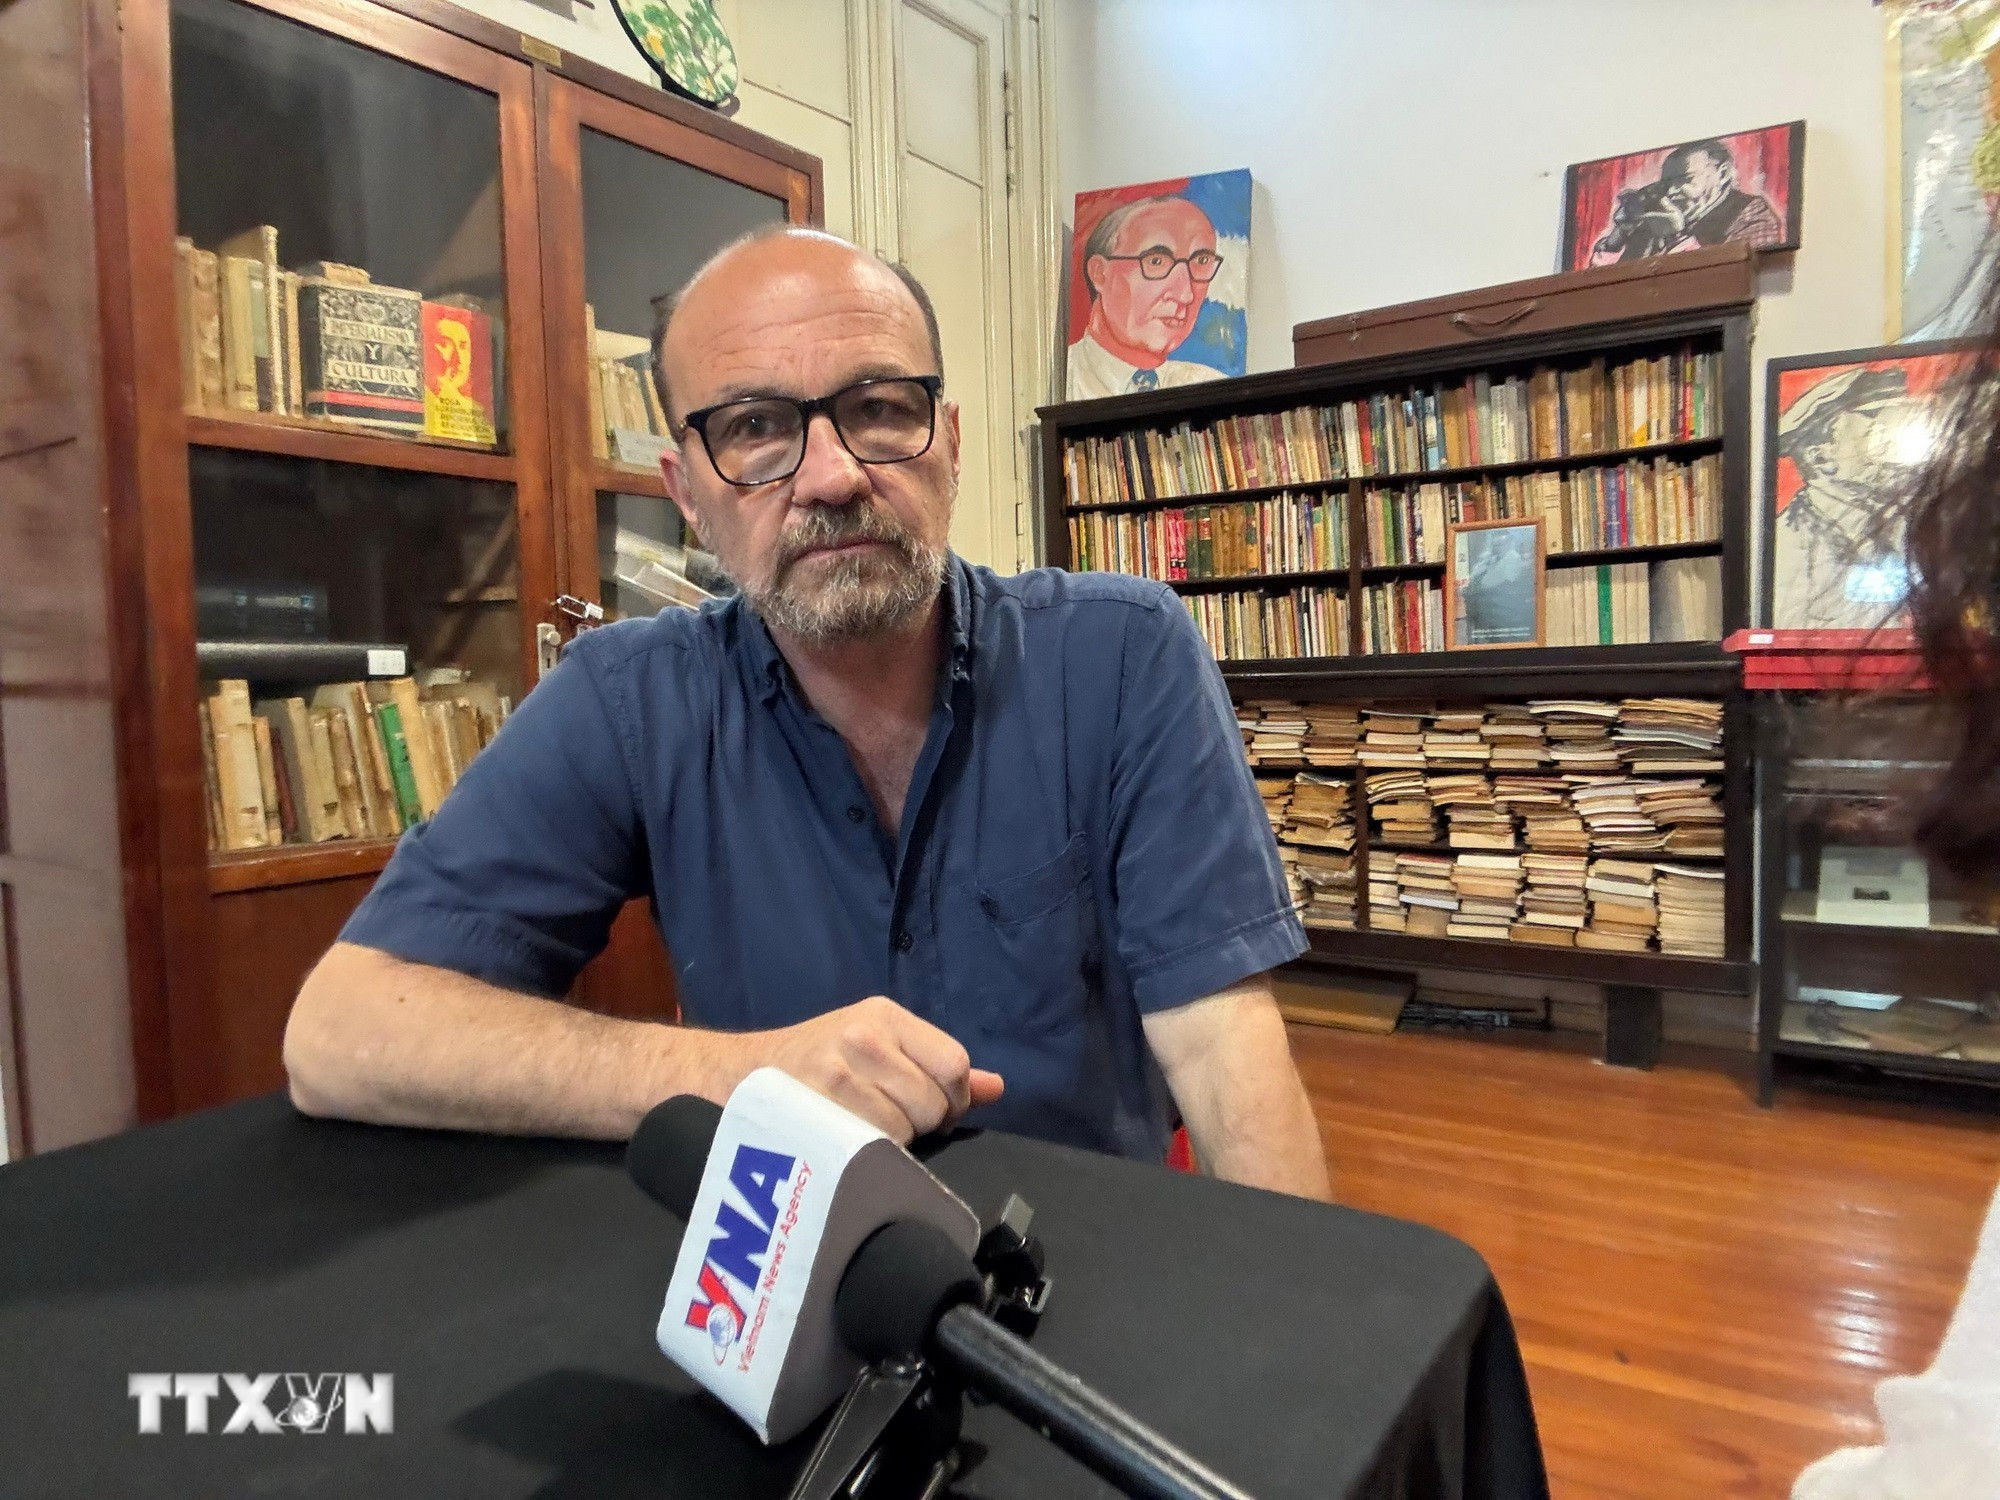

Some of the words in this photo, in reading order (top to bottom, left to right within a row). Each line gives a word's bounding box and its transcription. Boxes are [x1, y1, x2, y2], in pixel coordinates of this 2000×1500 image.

[332, 363, 409, 384] CULTURA
[365, 343, 381, 361] Y
[685, 1143, 797, 1343] VNA
[762, 1240, 787, 1293] News
[780, 1160, 812, 1239] Agency
